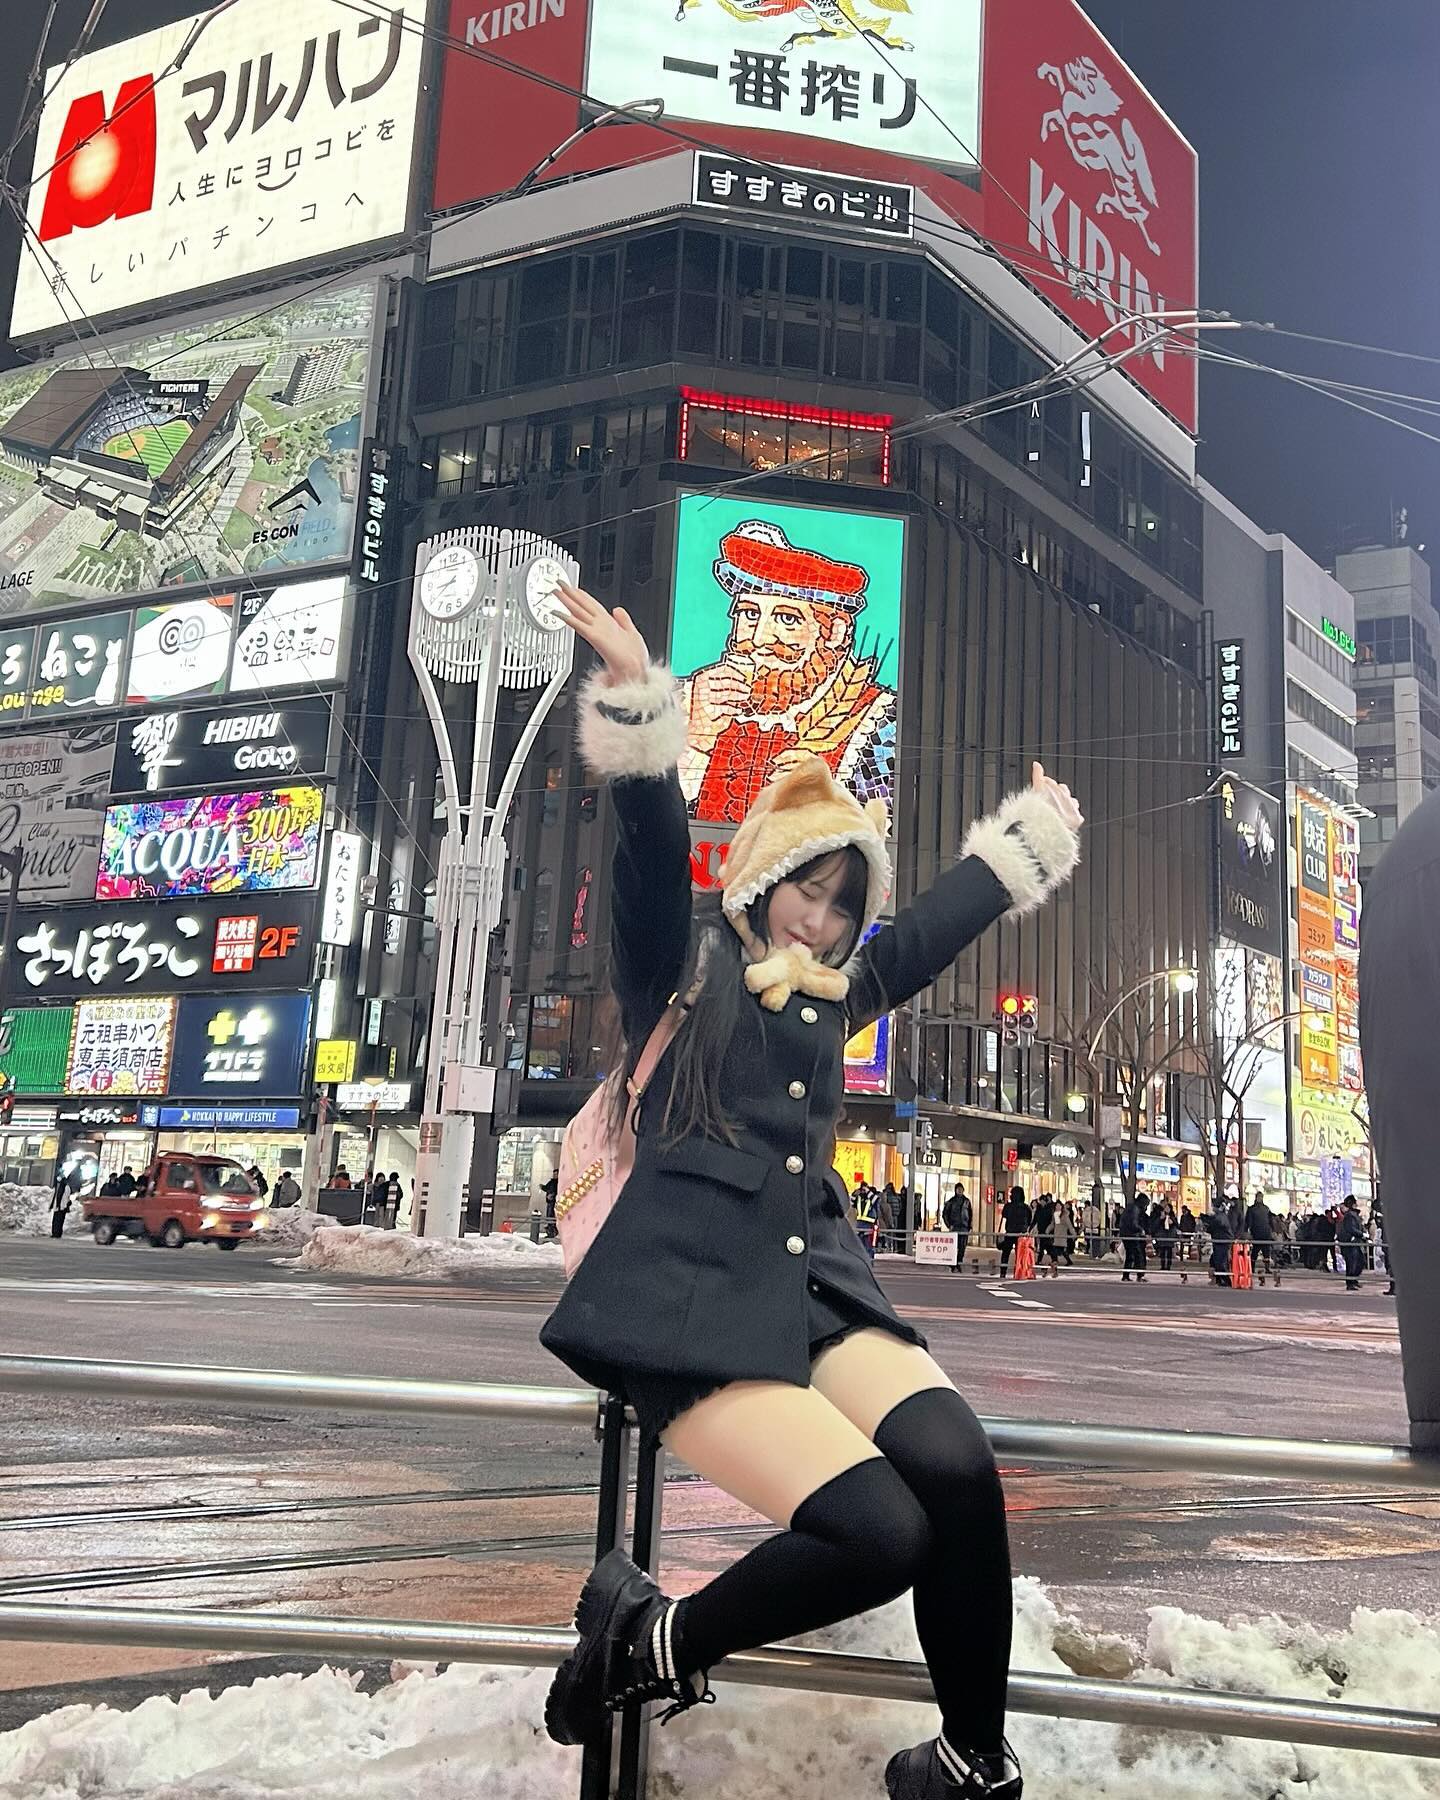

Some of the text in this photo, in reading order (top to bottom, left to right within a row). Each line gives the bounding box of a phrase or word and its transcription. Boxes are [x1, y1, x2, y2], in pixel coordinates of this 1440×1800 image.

[465, 0, 566, 48] KIRIN
[182, 8, 404, 153] マルハン
[663, 48, 917, 129] 一番搾り
[168, 119, 397, 206] 人生にヨロコビを
[709, 169, 899, 223] すすきのビル
[49, 191, 365, 295] 新しいパチンコへ
[1028, 157, 1166, 373] KIRIN
[160, 383, 200, 393] FIGHTERS
[271, 524, 299, 540] CON
[360, 448, 391, 583] すすきのビル
[243, 597, 263, 616] 2F
[0, 685, 65, 711] ounge
[1221, 645, 1241, 752] すすきのビル
[202, 712, 281, 745] HIBIKI
[131, 712, 184, 791] 響
[243, 807, 311, 845] 300坪
[1304, 818, 1326, 856] 快活
[107, 825, 243, 881] ACQUA
[248, 843, 308, 876] 日本一
[1305, 854, 1327, 882] CLUB
[16, 916, 200, 987] さっぽろっこ
[259, 926, 300, 958] 2F
[80, 1023, 157, 1045] 元祖串かつ
[76, 1046, 163, 1069] 恵美須商店
[223, 1111, 244, 1122] HAPPY
[245, 1111, 277, 1122] LIFESTYLE
[925, 1245, 948, 1254] STOP
